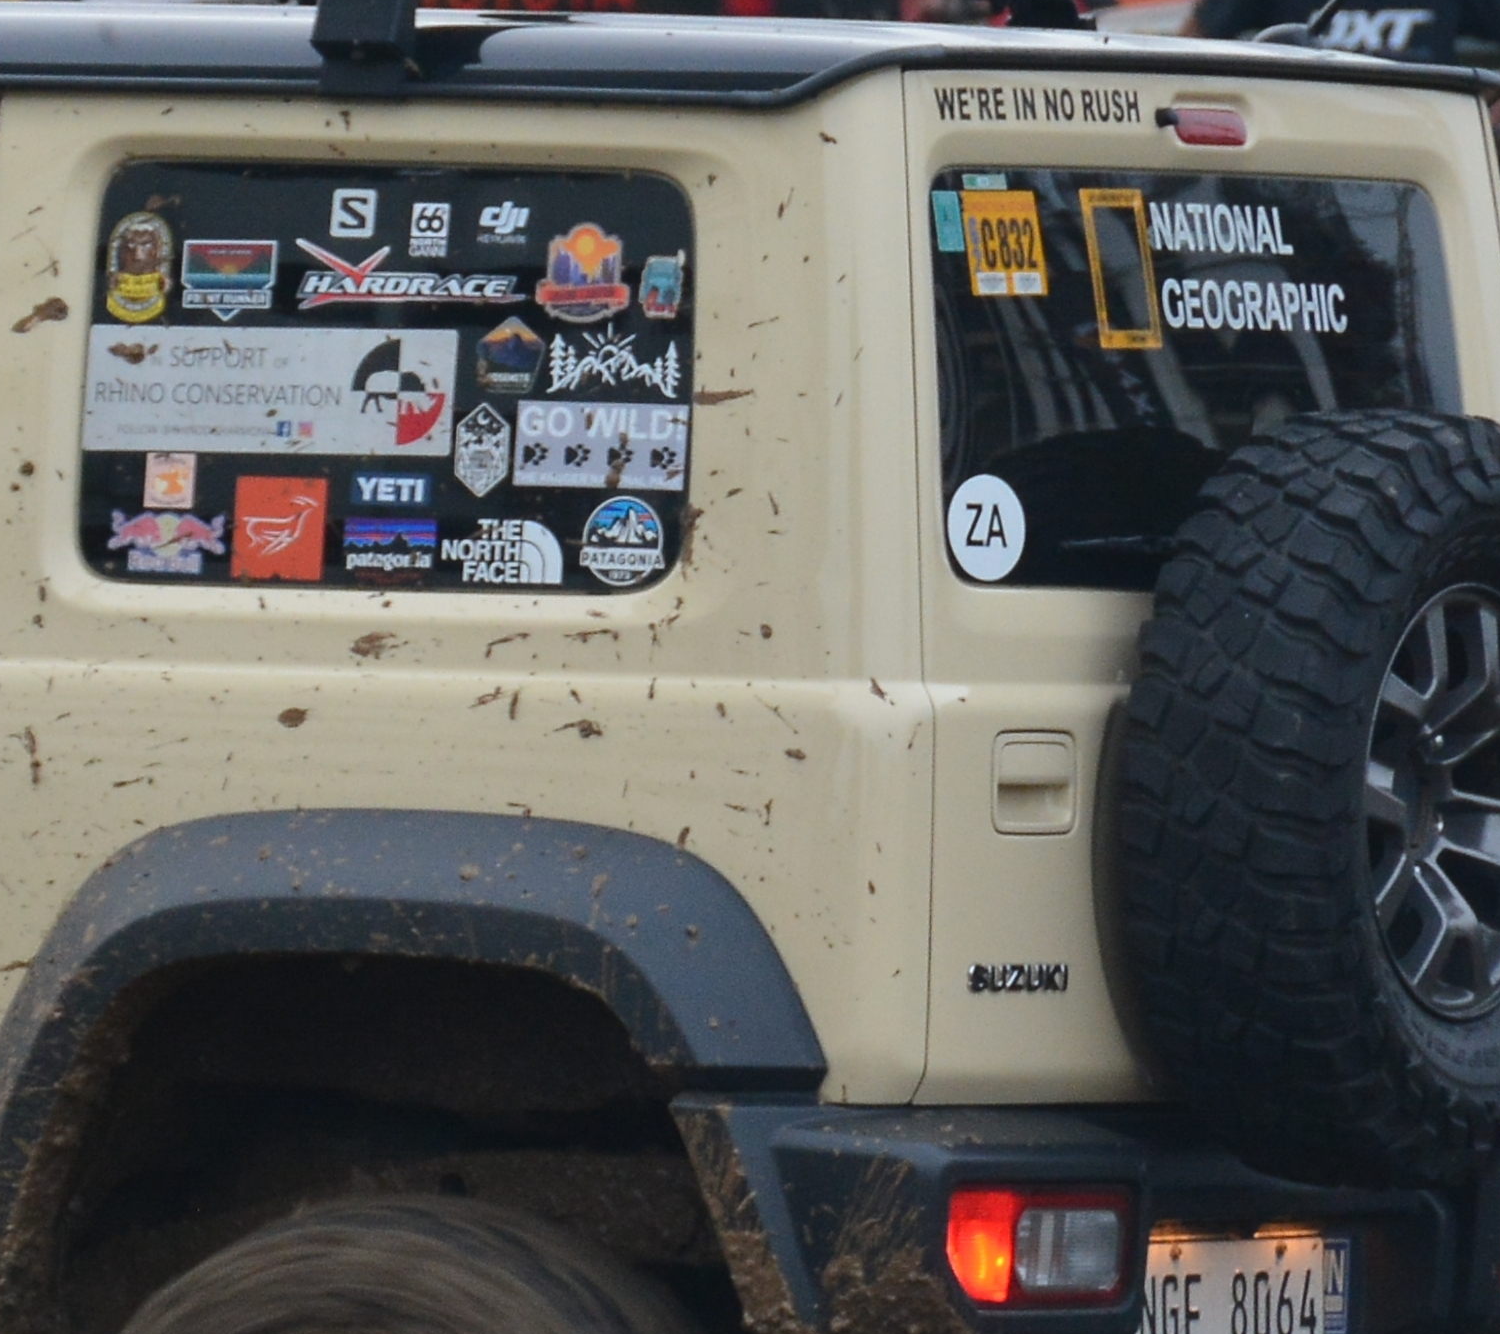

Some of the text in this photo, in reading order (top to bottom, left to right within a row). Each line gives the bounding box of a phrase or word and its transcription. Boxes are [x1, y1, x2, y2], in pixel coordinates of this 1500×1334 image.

[934, 87, 1141, 124] WE'RE IN NO RUSH
[1149, 201, 1294, 256] NATIONAL
[303, 275, 509, 297] HARDRACE
[1162, 278, 1348, 334] GEOGRAPHIC
[170, 345, 268, 368] SUPPORT
[94, 382, 343, 407] RHINO CONSERVATION
[520, 405, 574, 438] GO
[357, 477, 425, 503] YETI
[477, 519, 523, 540] THE
[965, 503, 1007, 548] ZA
[441, 539, 521, 562] NORTH
[581, 552, 662, 566] PATAGONIA
[462, 562, 520, 583] FACE
[967, 964, 1068, 992] SUZUKI
